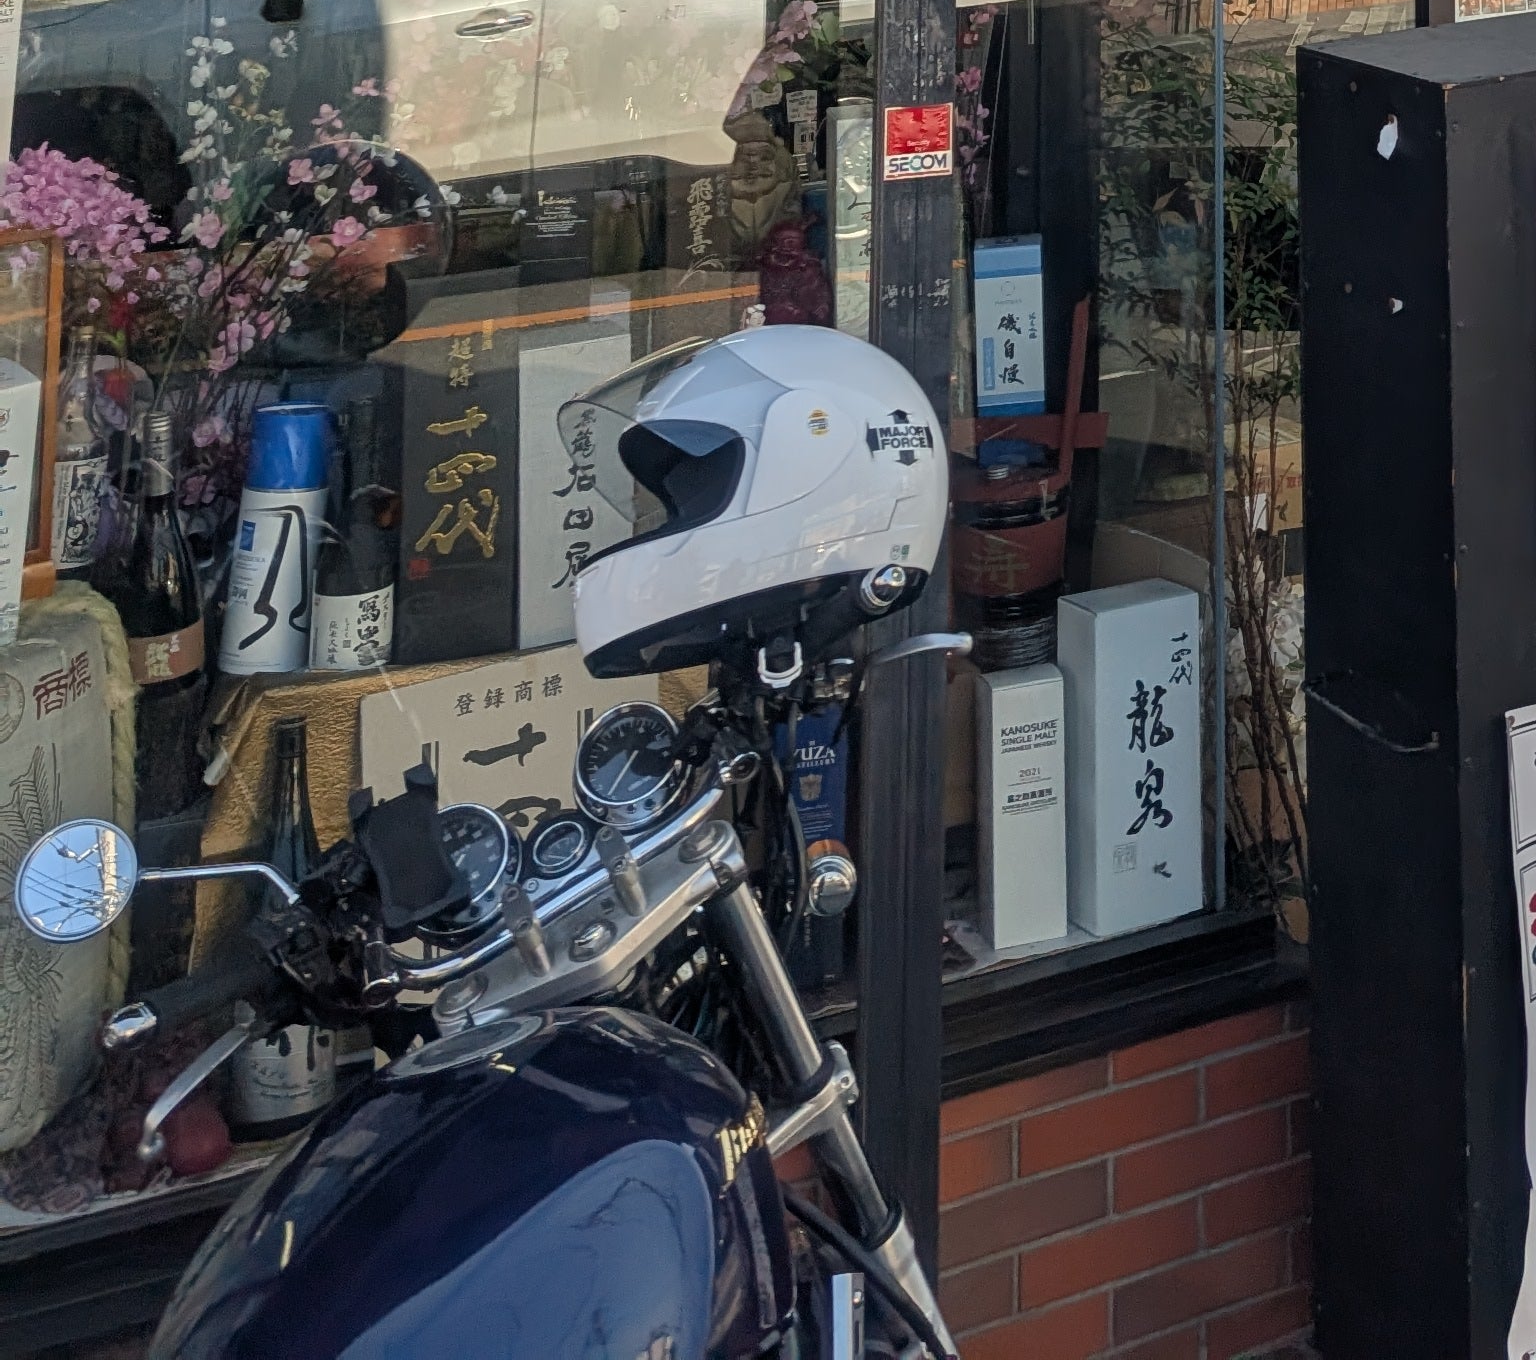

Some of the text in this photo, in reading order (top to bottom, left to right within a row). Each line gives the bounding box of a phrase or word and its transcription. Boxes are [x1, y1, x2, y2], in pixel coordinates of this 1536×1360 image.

[889, 153, 948, 173] SECOM
[997, 313, 1024, 385] 磯自慢
[879, 426, 925, 438] MAJOR
[880, 437, 927, 450] FORCE
[33, 651, 92, 721] 商標
[454, 675, 565, 716] 登録商標
[1000, 719, 1059, 738] KANOSUKE
[1001, 730, 1057, 746] SINGLE MALT
[1126, 680, 1174, 835] 龍泉
[1018, 767, 1041, 778] 2021
